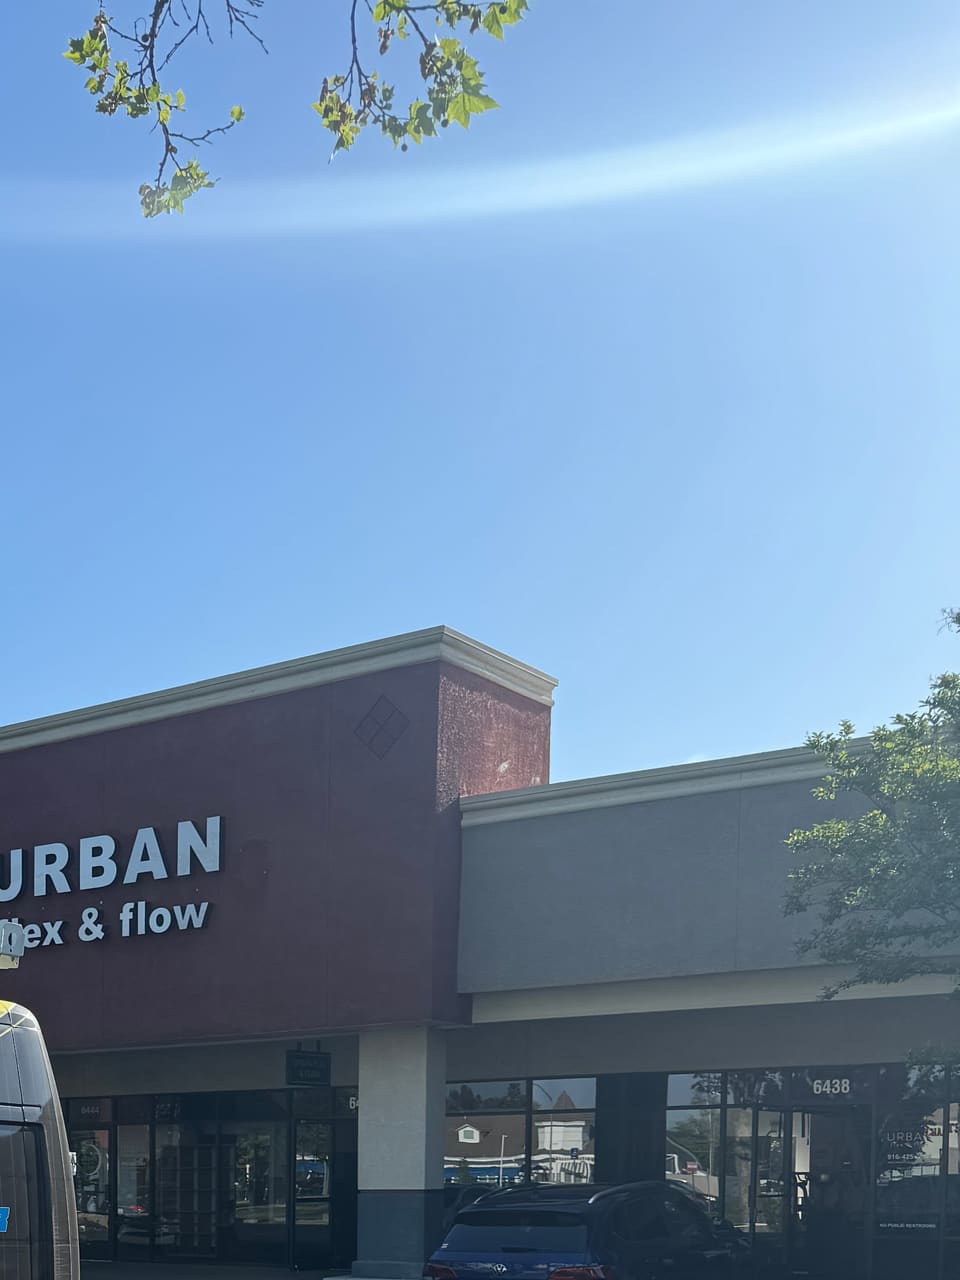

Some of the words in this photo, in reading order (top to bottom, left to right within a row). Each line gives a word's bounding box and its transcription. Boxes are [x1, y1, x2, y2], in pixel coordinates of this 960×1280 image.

[78, 907, 104, 942] &
[120, 901, 208, 937] flow
[813, 1079, 850, 1094] 6438
